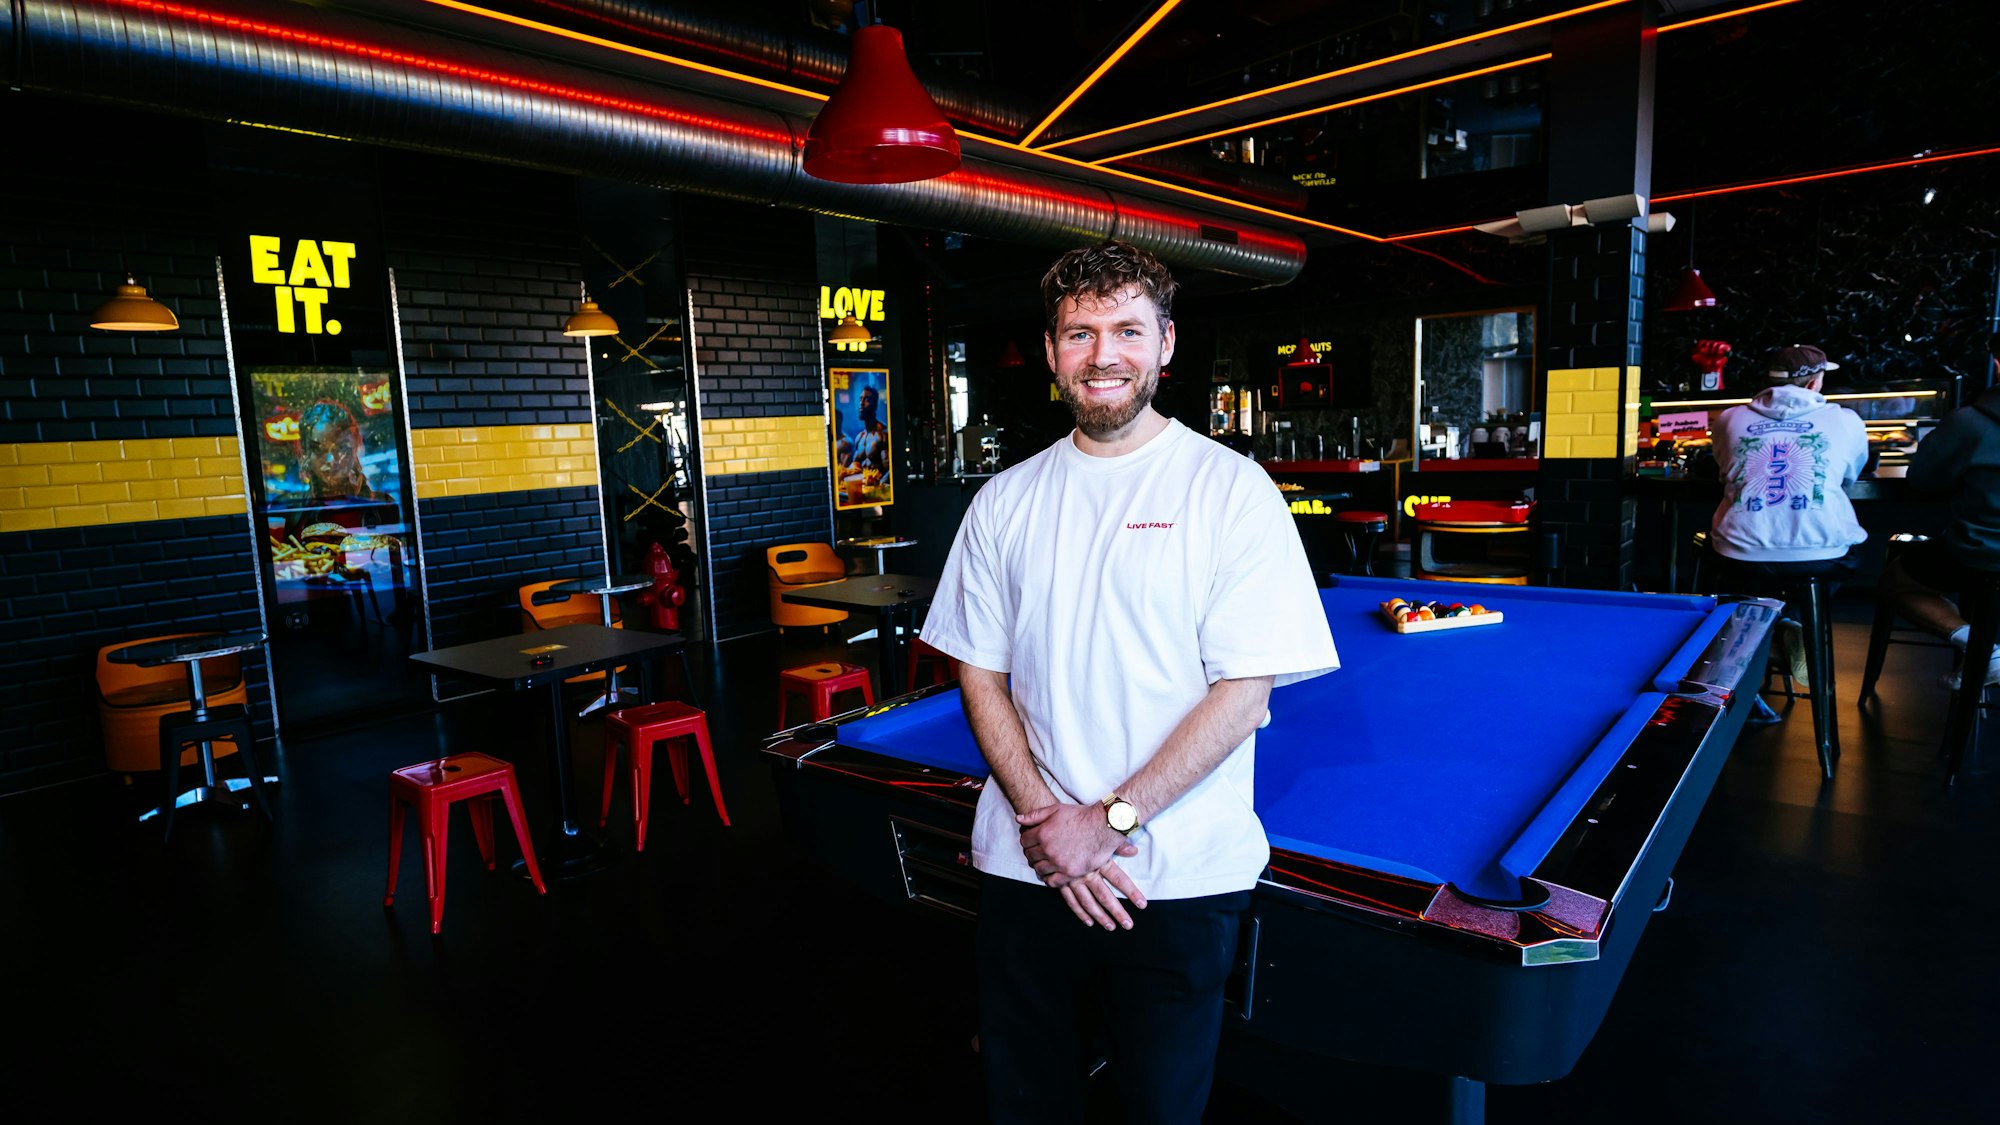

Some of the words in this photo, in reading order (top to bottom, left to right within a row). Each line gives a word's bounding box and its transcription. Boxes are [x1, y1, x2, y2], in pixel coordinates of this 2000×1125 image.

[249, 234, 356, 289] EAT
[274, 285, 342, 336] IT.
[820, 285, 885, 321] LOVE
[1768, 444, 1788, 505] ドラゴン
